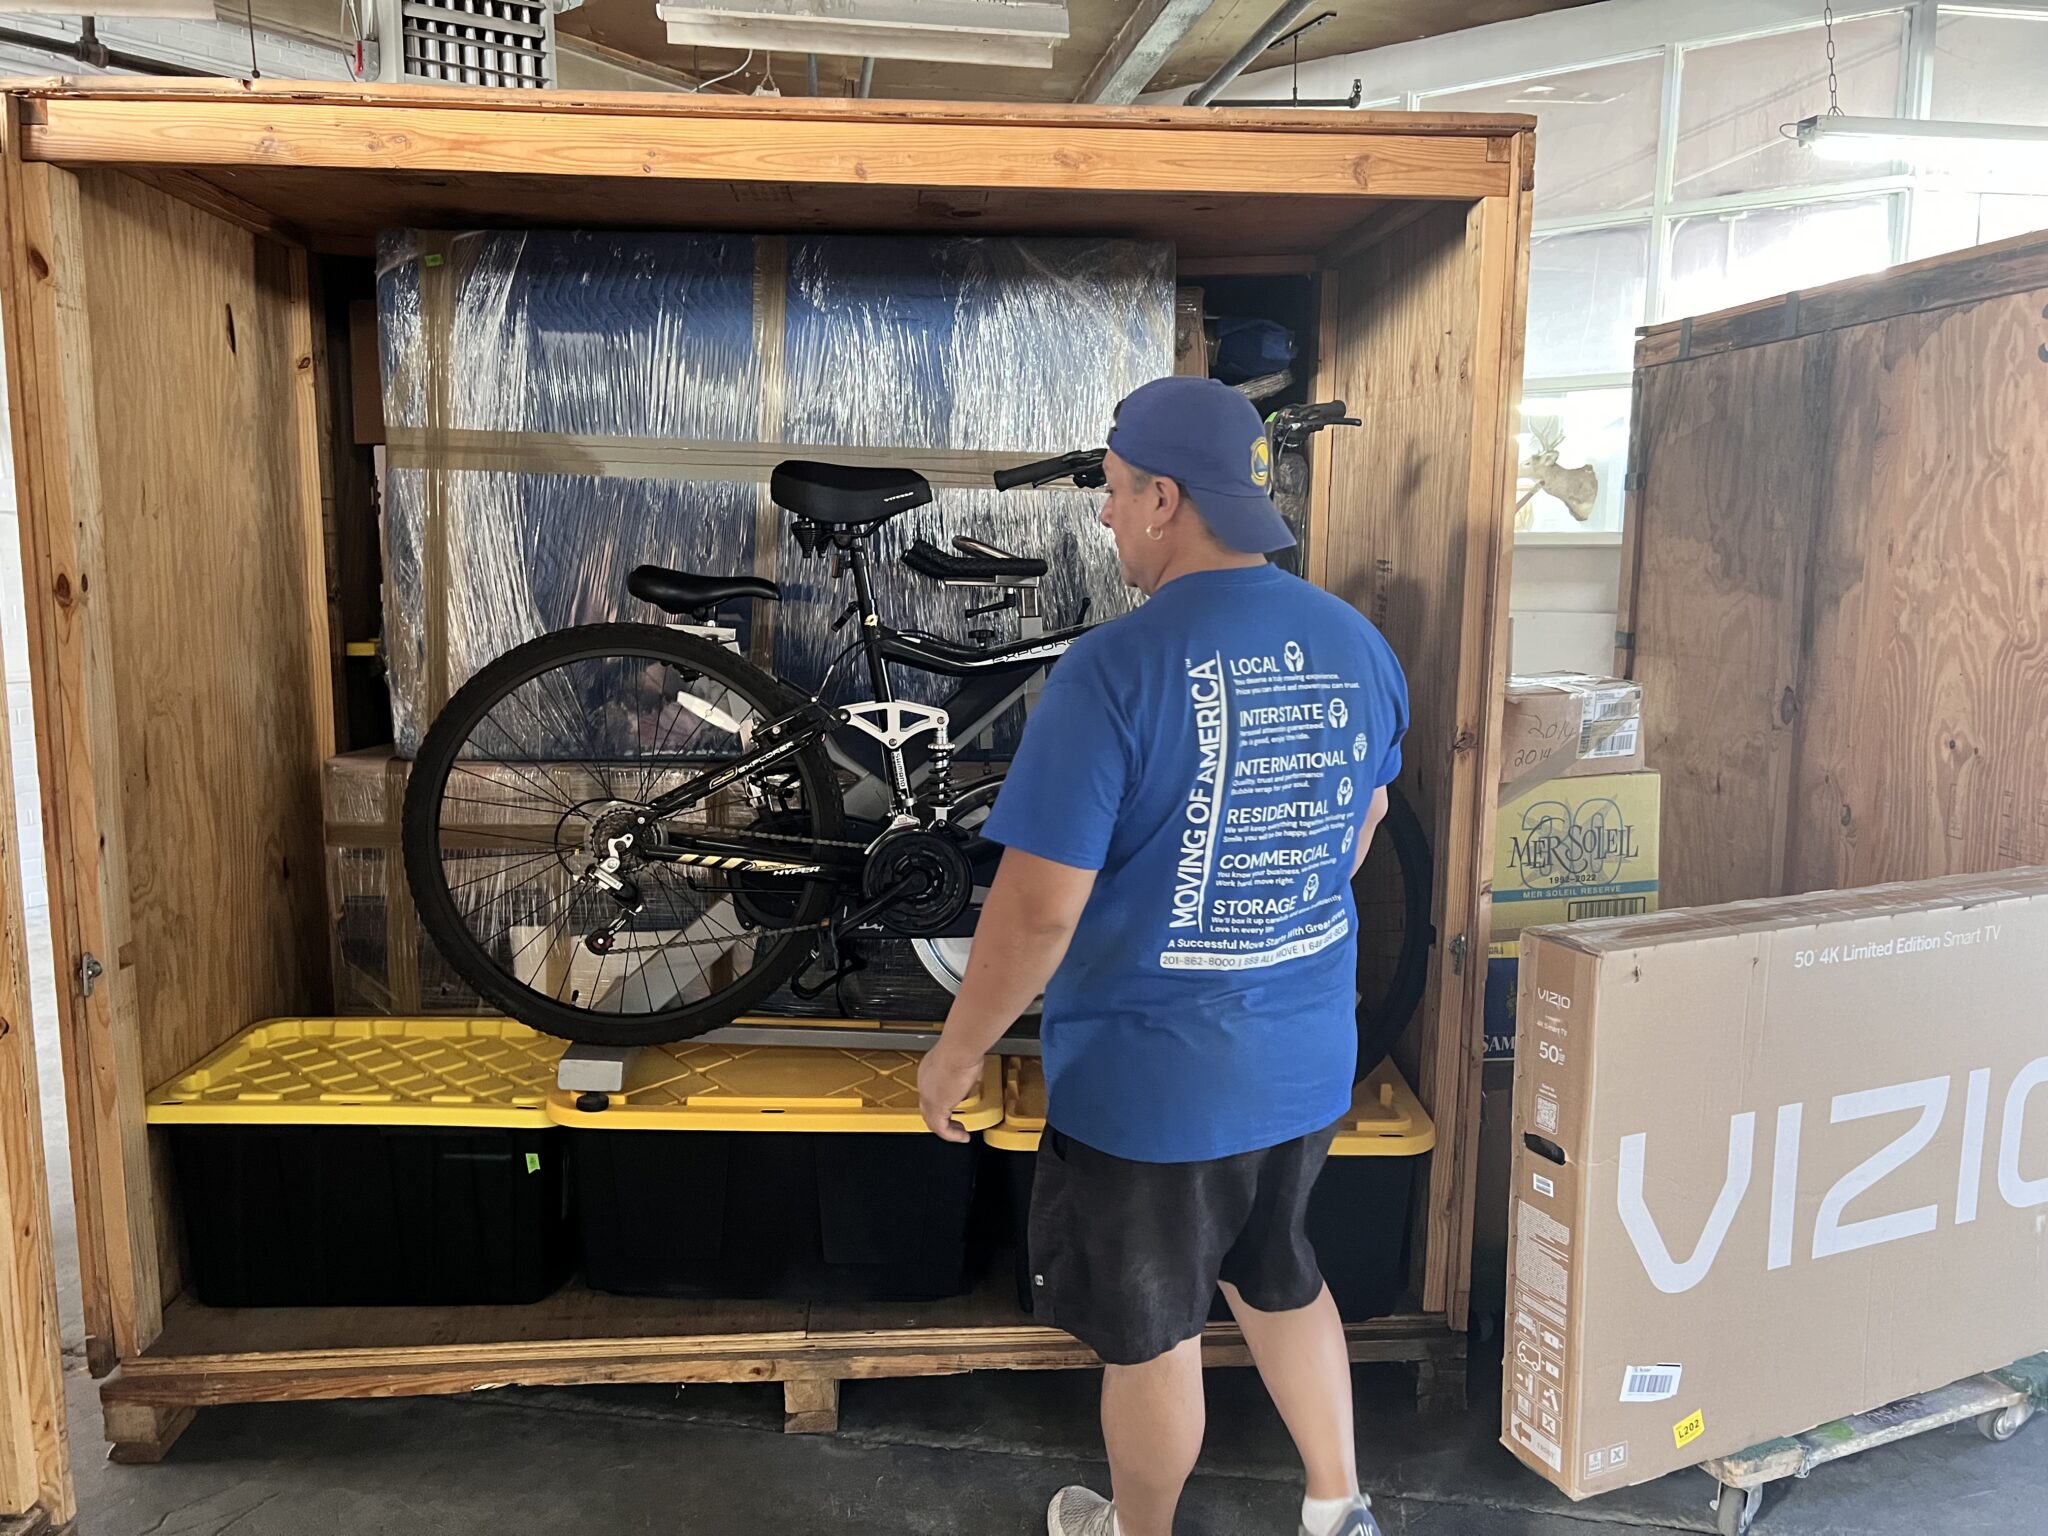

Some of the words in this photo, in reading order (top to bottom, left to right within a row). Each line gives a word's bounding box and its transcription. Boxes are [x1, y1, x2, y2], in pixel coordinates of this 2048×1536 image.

[1230, 656, 1280, 676] LOCAL
[1188, 659, 1221, 784] AMERICA
[1239, 703, 1324, 727] INTERSTATE
[1235, 750, 1348, 777] INTERNATIONAL
[1514, 748, 1551, 767] 2014
[1186, 788, 1214, 825] OF
[1227, 800, 1329, 824] RESIDENTIAL
[1563, 825, 1638, 861] SOLEIL
[1219, 843, 1330, 869] COMMERCIAL
[773, 866, 821, 876] HYPER
[1169, 828, 1207, 928] MOVING
[1522, 891, 1543, 899] MER
[1545, 888, 1578, 896] SOLEIL
[1580, 885, 1623, 895] RESERVE
[1212, 895, 1298, 915] STORAGE
[1210, 925, 1230, 933] Love
[1167, 939, 1175, 948] A
[1177, 938, 1237, 950] Successful
[1239, 940, 1264, 950] Move
[1819, 946, 1840, 965] 4K
[1844, 939, 1893, 962] Limited
[1896, 936, 1941, 954] Edition
[1943, 928, 1981, 948] Smart
[1985, 924, 2002, 942] TV
[1537, 987, 1571, 1009] VIZIO
[1678, 1419, 1700, 1439] L202
